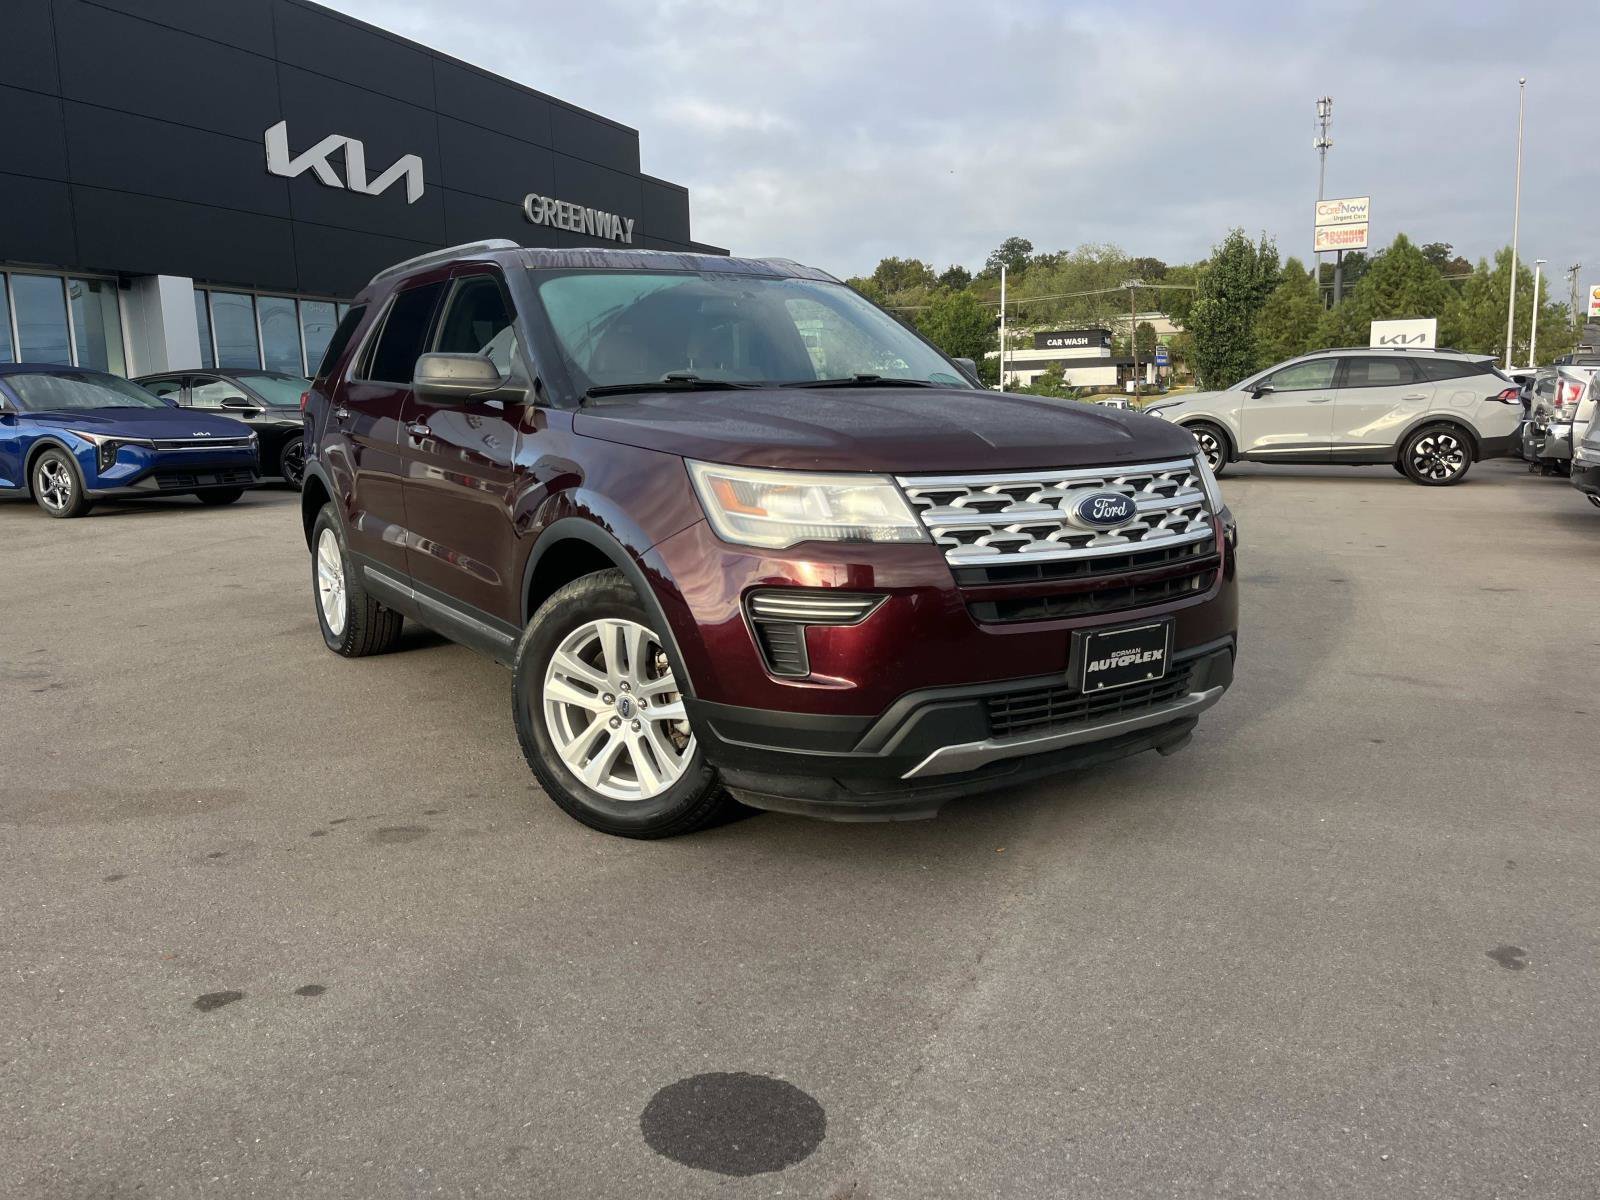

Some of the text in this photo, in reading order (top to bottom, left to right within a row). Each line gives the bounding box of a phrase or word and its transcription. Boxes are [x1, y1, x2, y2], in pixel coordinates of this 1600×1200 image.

[264, 120, 424, 204] KIA
[1318, 203, 1367, 215] CareNow
[524, 193, 635, 244] GREENWAY
[1333, 214, 1353, 222] Urgent
[1064, 337, 1088, 346] WASH
[1380, 333, 1426, 344] KIA
[1092, 498, 1127, 518] Ford
[1111, 647, 1141, 658] BORMAN
[1087, 649, 1164, 673] AUTOPLEX
